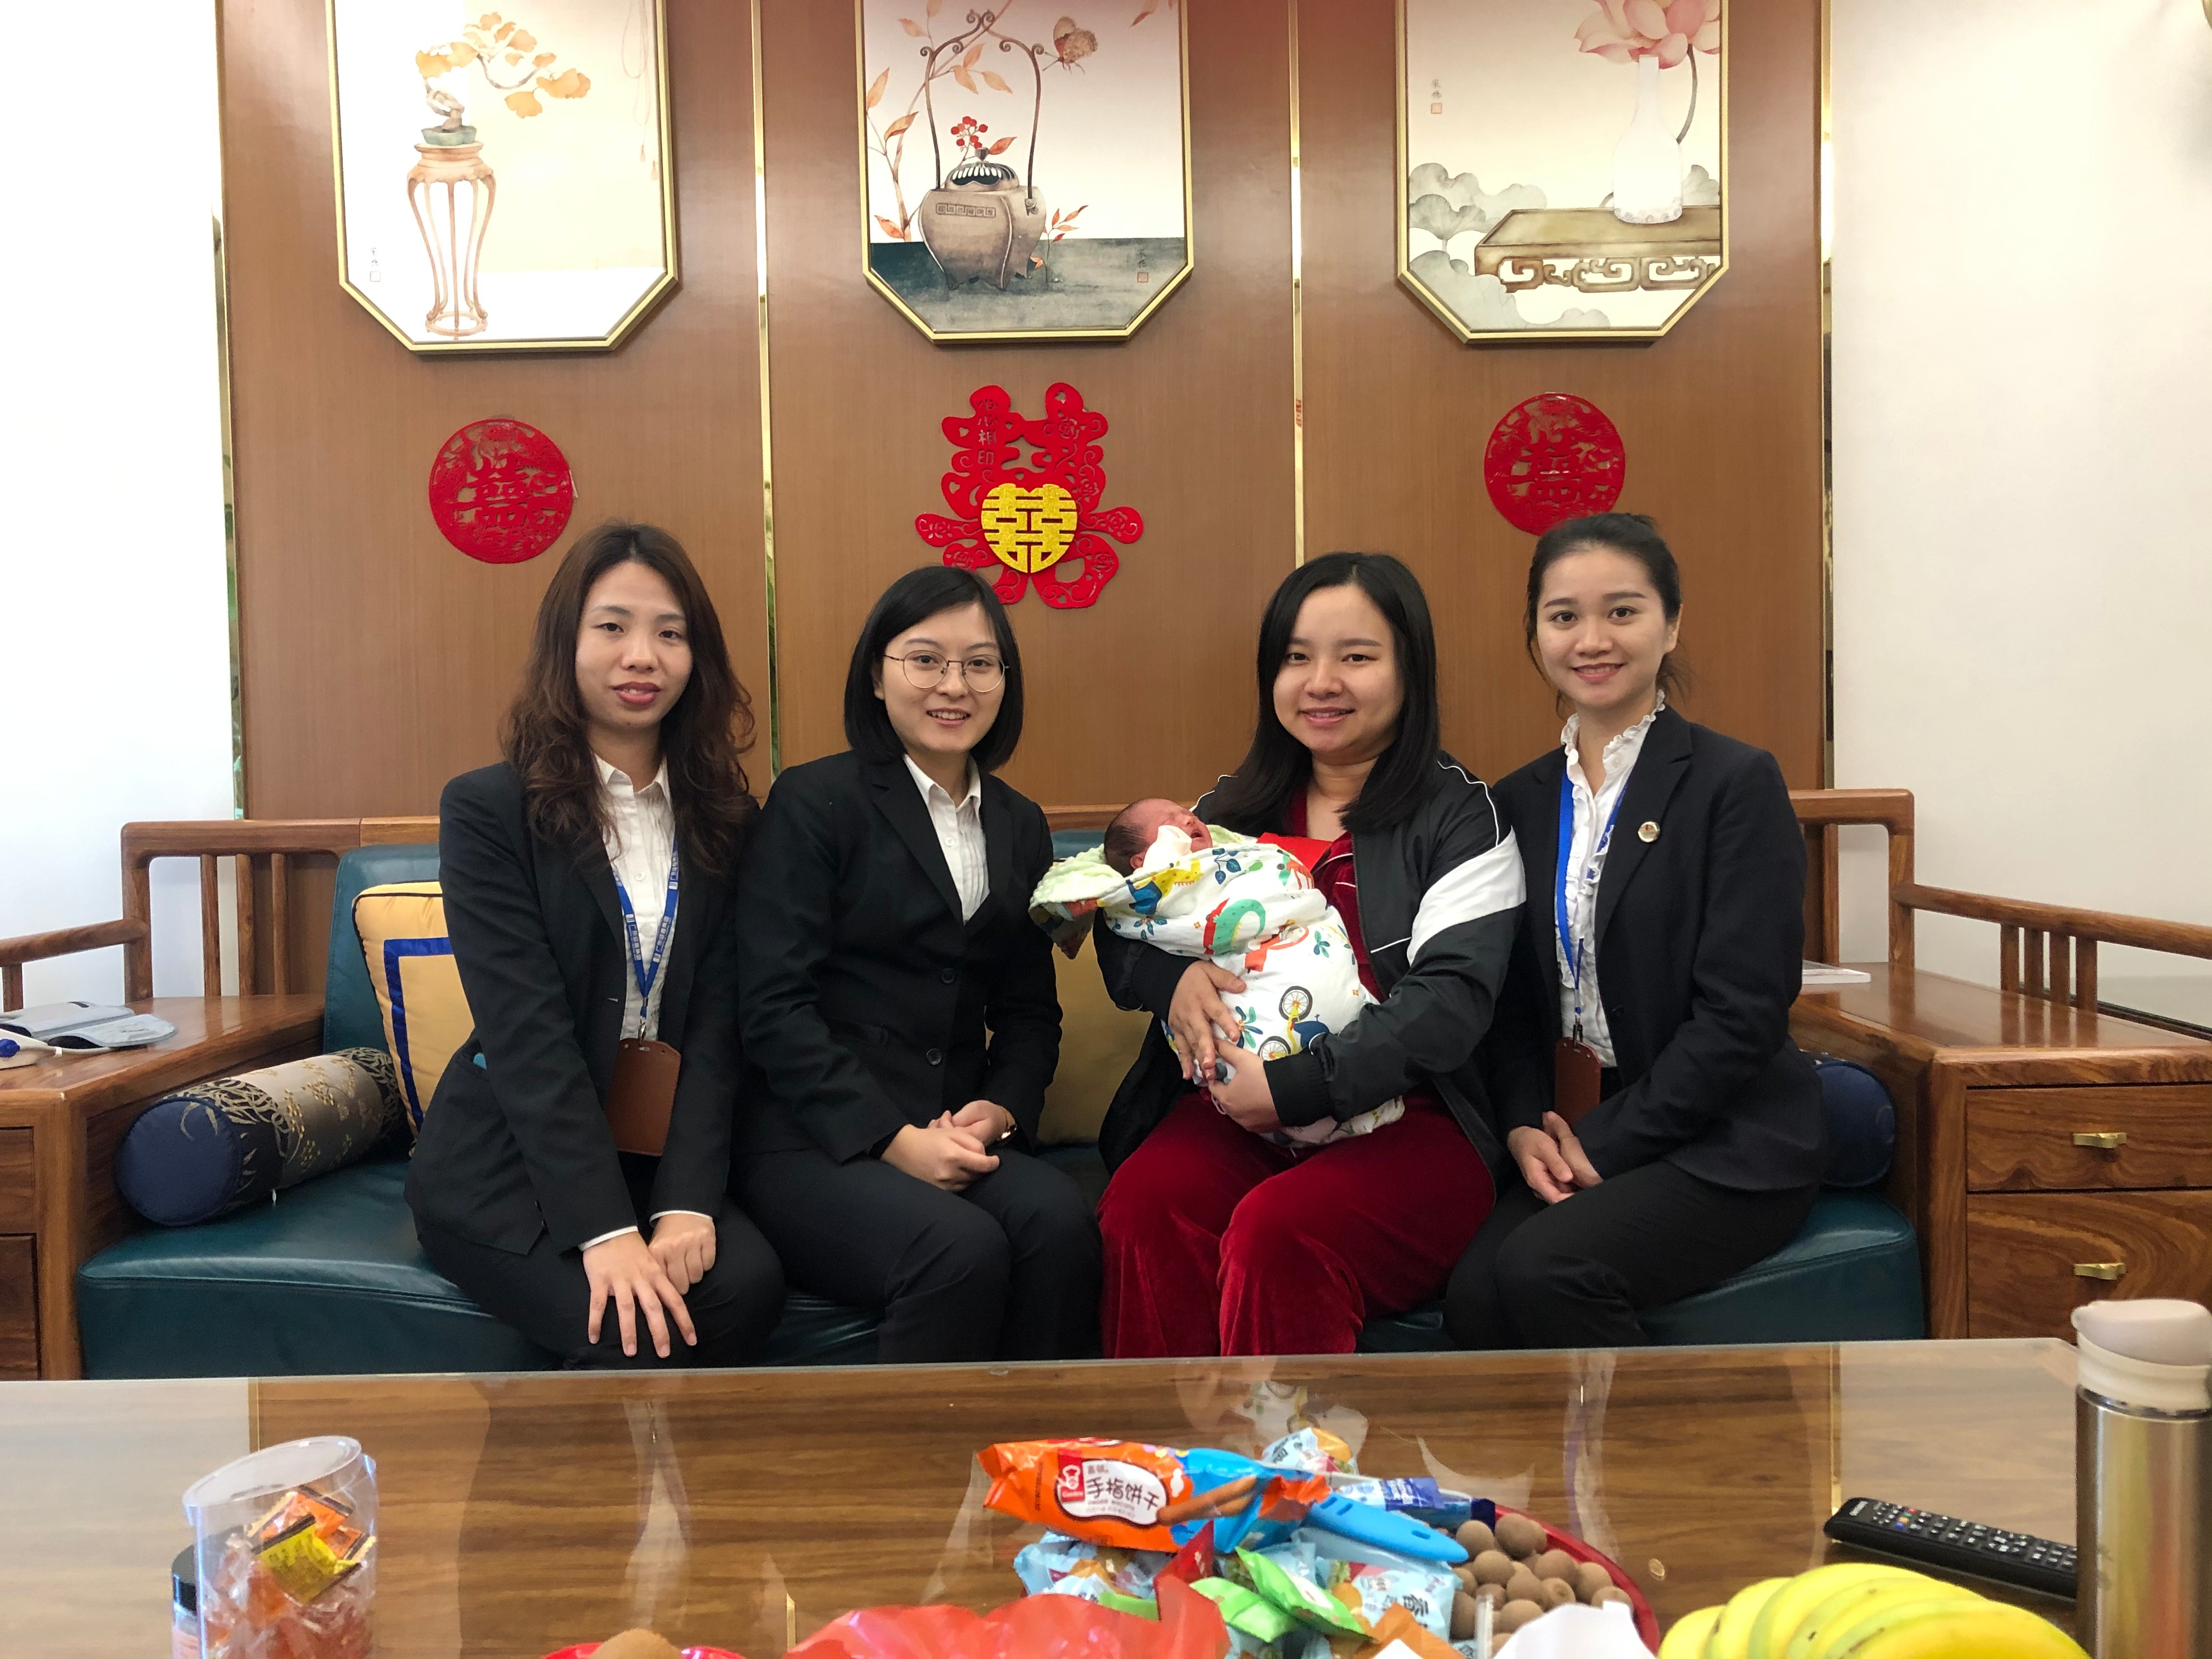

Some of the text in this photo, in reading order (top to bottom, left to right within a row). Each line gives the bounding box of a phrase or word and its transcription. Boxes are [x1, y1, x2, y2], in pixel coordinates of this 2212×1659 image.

[977, 399, 999, 465] 心心相印
[1086, 1477, 1160, 1511] 手指饼干
